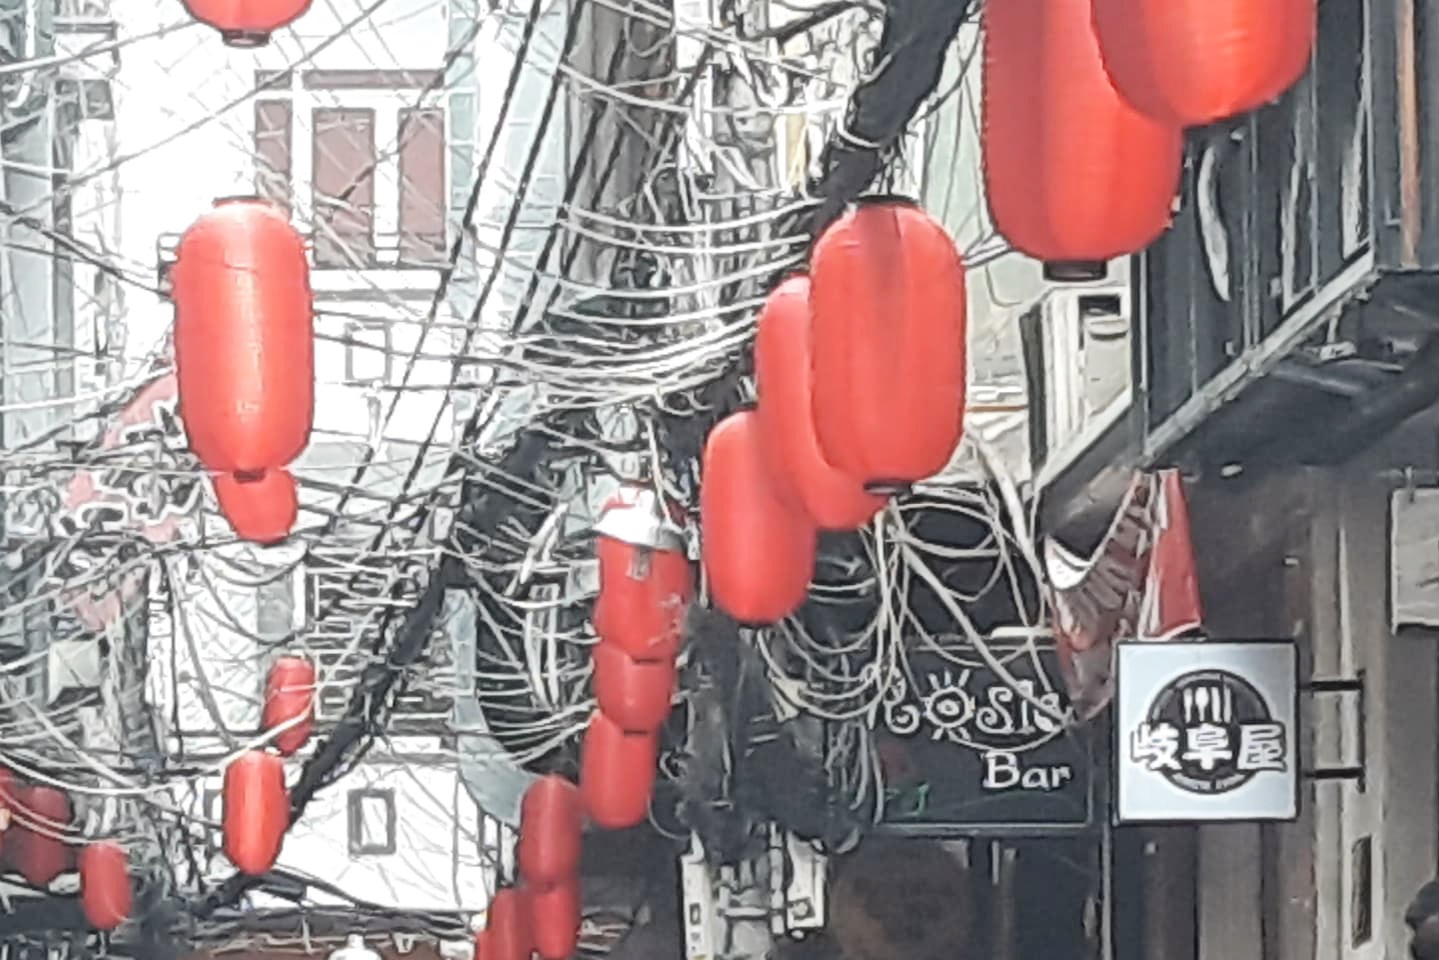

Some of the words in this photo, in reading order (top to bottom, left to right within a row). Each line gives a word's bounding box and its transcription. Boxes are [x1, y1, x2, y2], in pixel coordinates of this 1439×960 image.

[1132, 722, 1287, 772] 岐阜屋
[982, 751, 1072, 789] Bar
